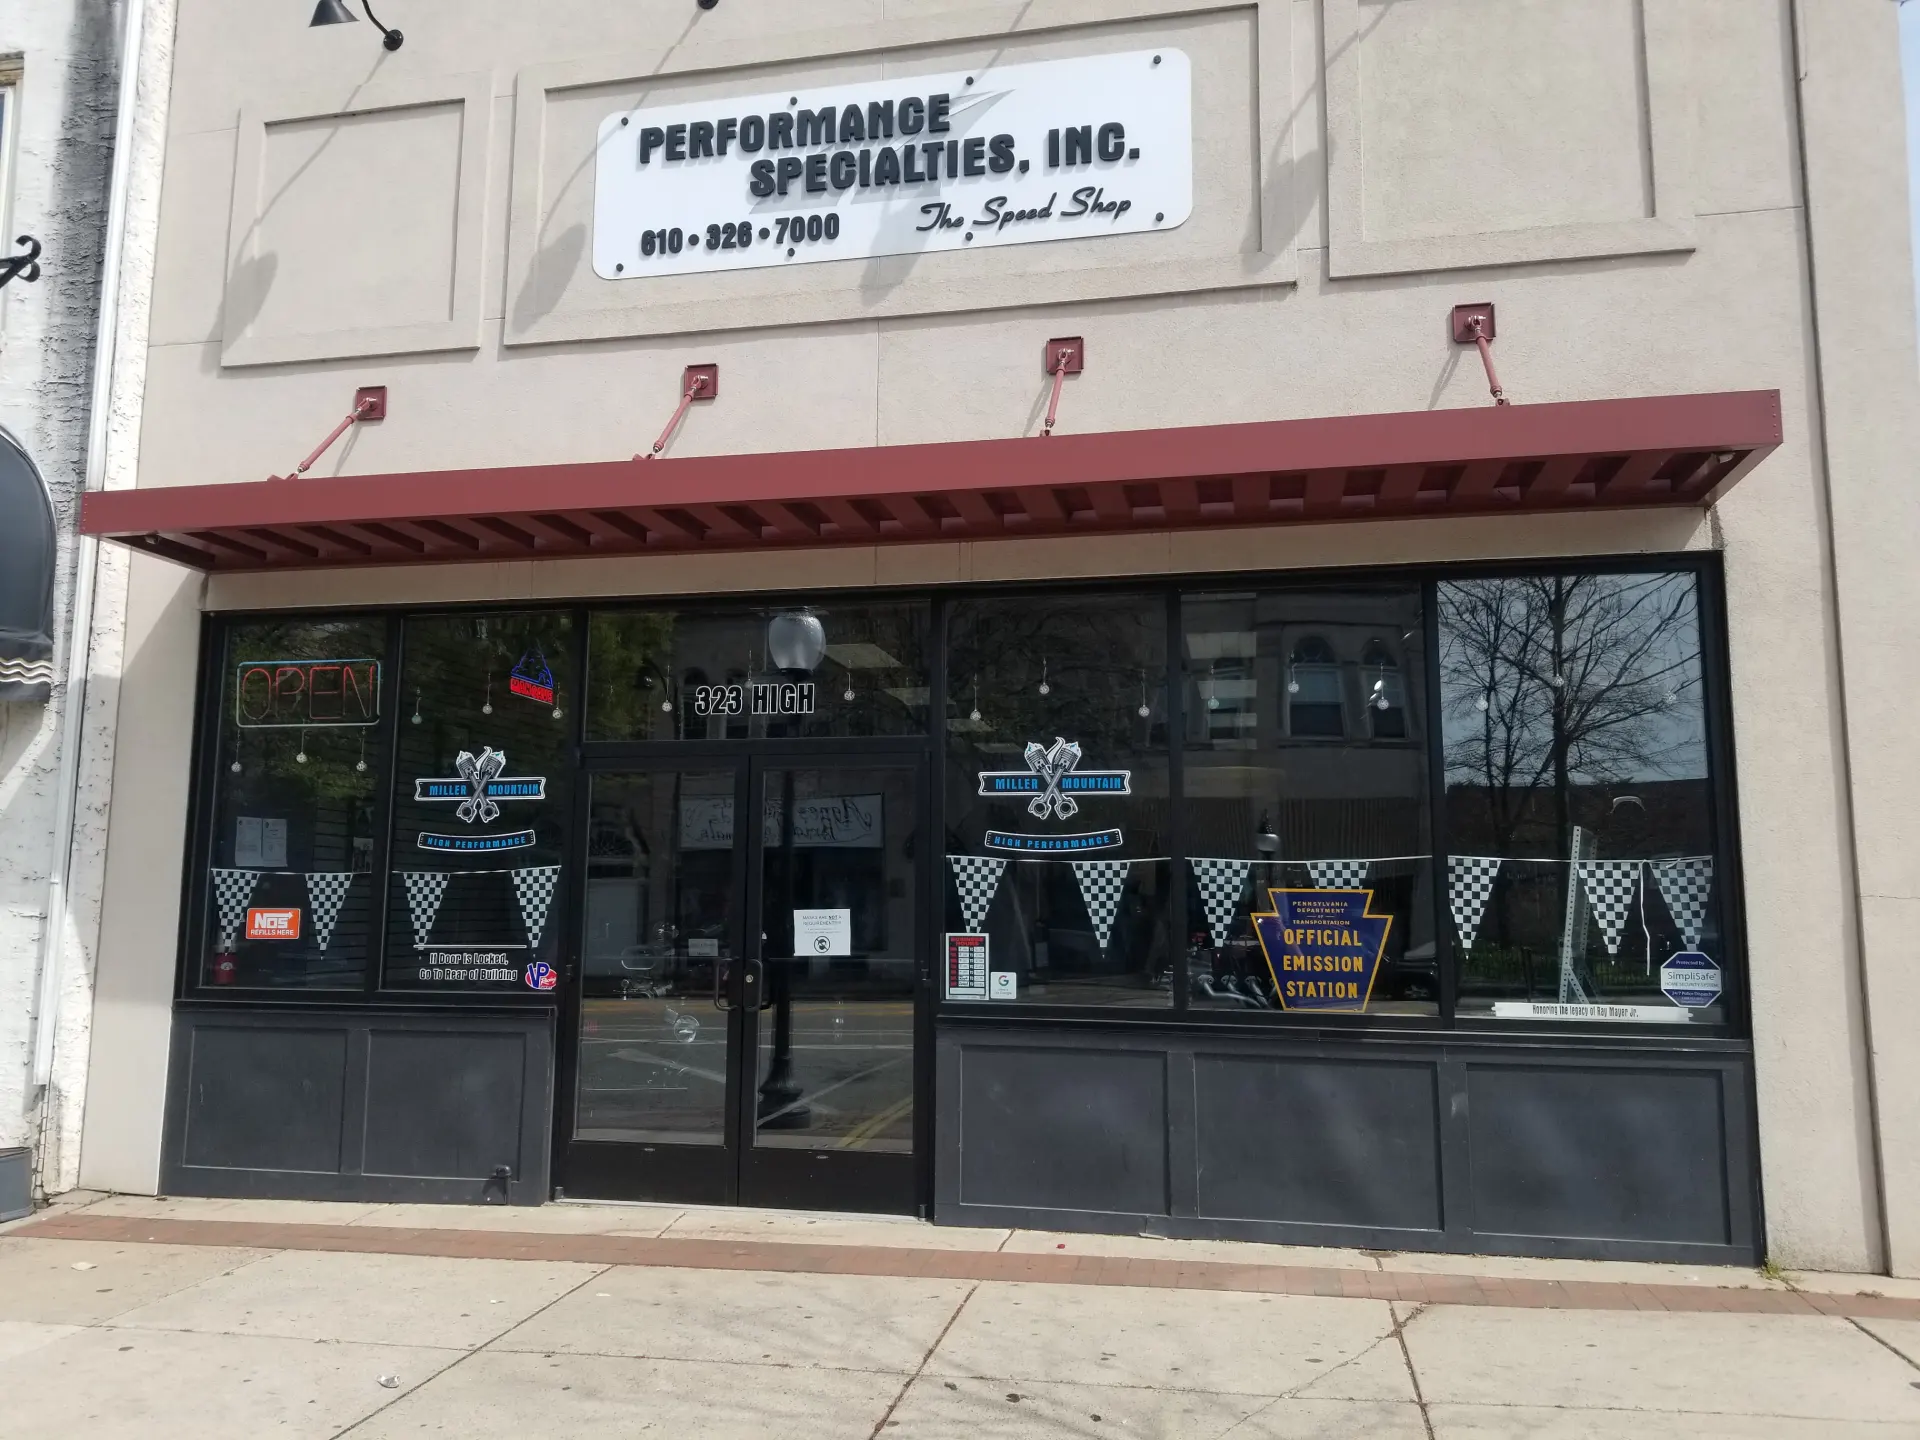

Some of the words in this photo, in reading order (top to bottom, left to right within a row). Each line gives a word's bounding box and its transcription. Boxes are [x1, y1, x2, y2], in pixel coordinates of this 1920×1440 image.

[640, 93, 950, 164] PERFORMANCE
[750, 134, 1030, 197] SPECIALTIES,
[1049, 122, 1140, 167] INC.
[916, 202, 964, 231] The
[972, 192, 1057, 230] Speed
[1061, 186, 1131, 220] Shop
[242, 665, 376, 720] OPEN
[695, 685, 743, 715] 323
[752, 683, 815, 714] HIGH
[429, 785, 467, 796] MILLER
[488, 783, 539, 795] MOUNTAIN
[995, 778, 1038, 790] MILLER
[1062, 777, 1121, 789] MOUNTAIN
[427, 837, 451, 848] HIGH
[455, 836, 526, 849] PERFORMANCE
[994, 836, 1021, 847] HIGH
[1027, 835, 1110, 849] PERFORMANCE
[254, 912, 294, 929] NOS
[1283, 929, 1363, 947] OFFICIAL
[439, 953, 462, 965] Door
[473, 952, 509, 965] Locked,
[1283, 955, 1364, 972] EMISSION
[419, 968, 431, 980] Go
[433, 968, 444, 980] To
[444, 968, 467, 980] Rear
[469, 969, 478, 980] of
[480, 968, 518, 981] Building
[1286, 981, 1358, 999] STATION
[1532, 1004, 1558, 1016] Honoring
[1559, 1005, 1568, 1015] the
[1569, 1005, 1588, 1017] legacy
[1590, 1006, 1596, 1016] of
[1597, 1007, 1607, 1018] Ray
[1609, 1007, 1629, 1018] Mayer
[1630, 1007, 1639, 1018] Jr.
